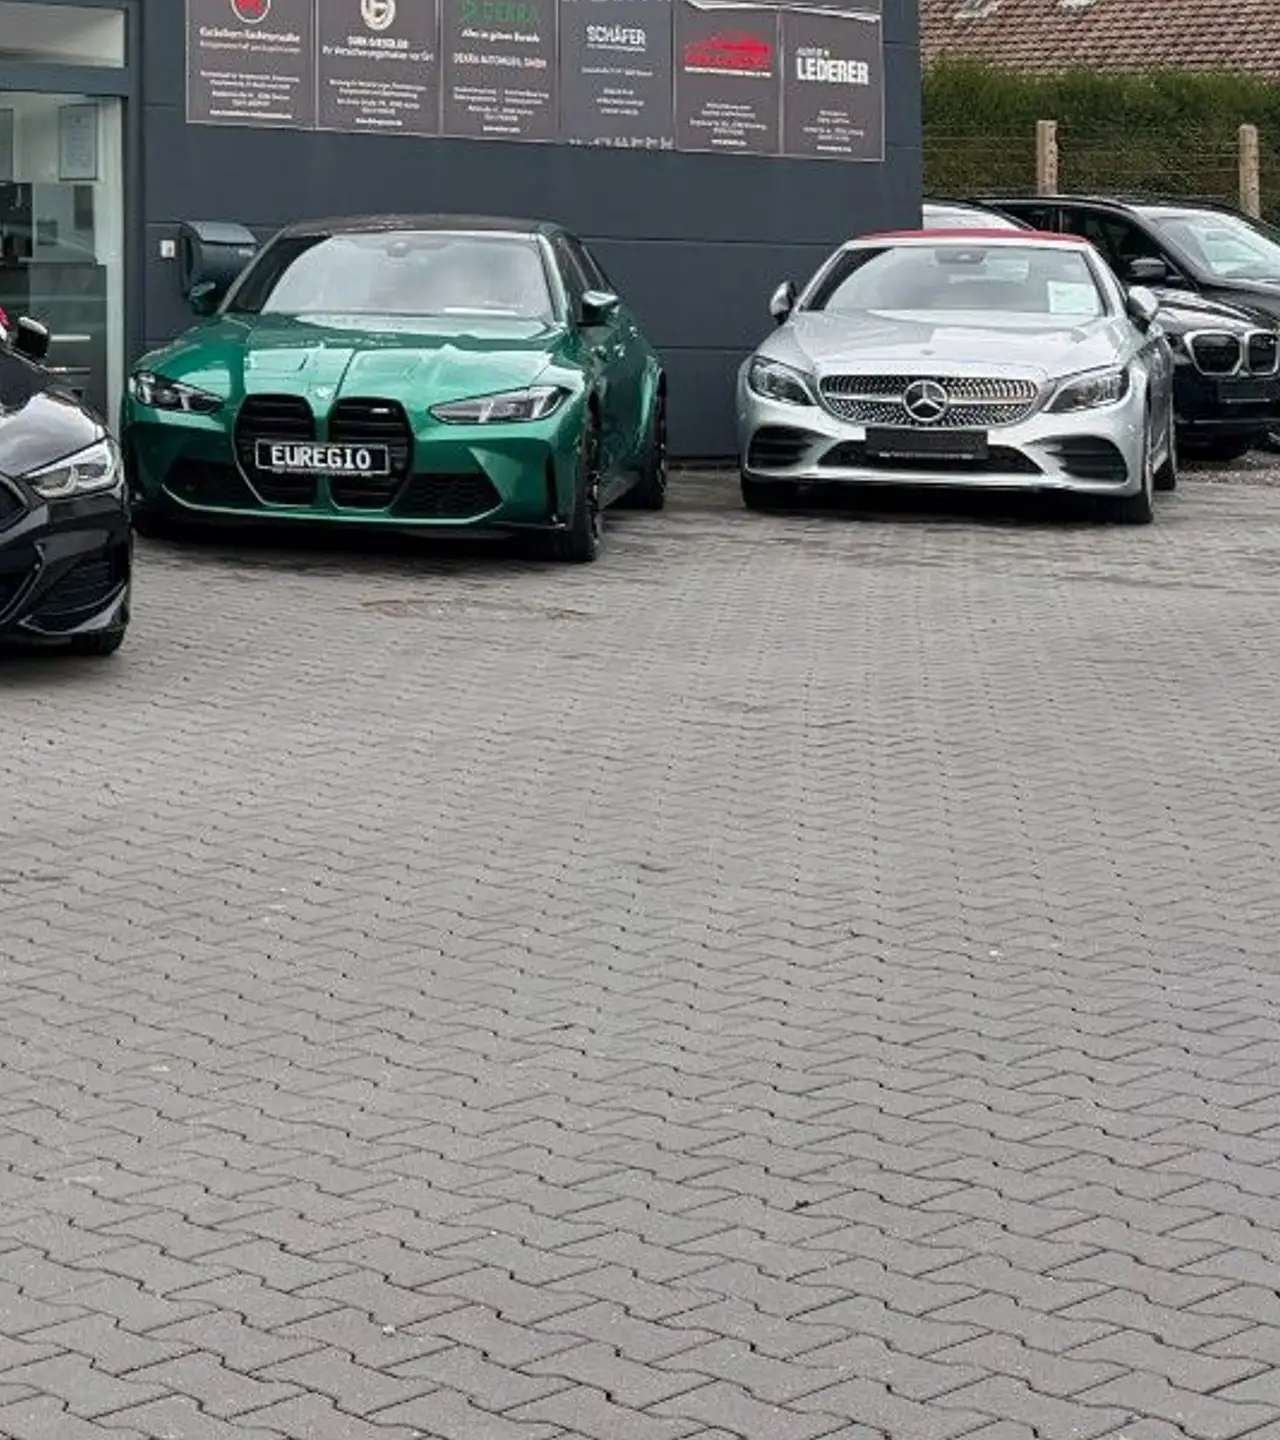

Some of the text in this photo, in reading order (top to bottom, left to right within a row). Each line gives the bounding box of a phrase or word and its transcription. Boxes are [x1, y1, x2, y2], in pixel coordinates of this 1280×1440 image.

[586, 24, 646, 46] SCHÄFER
[796, 57, 869, 85] LEDERER
[271, 445, 372, 470] EUREGIO
